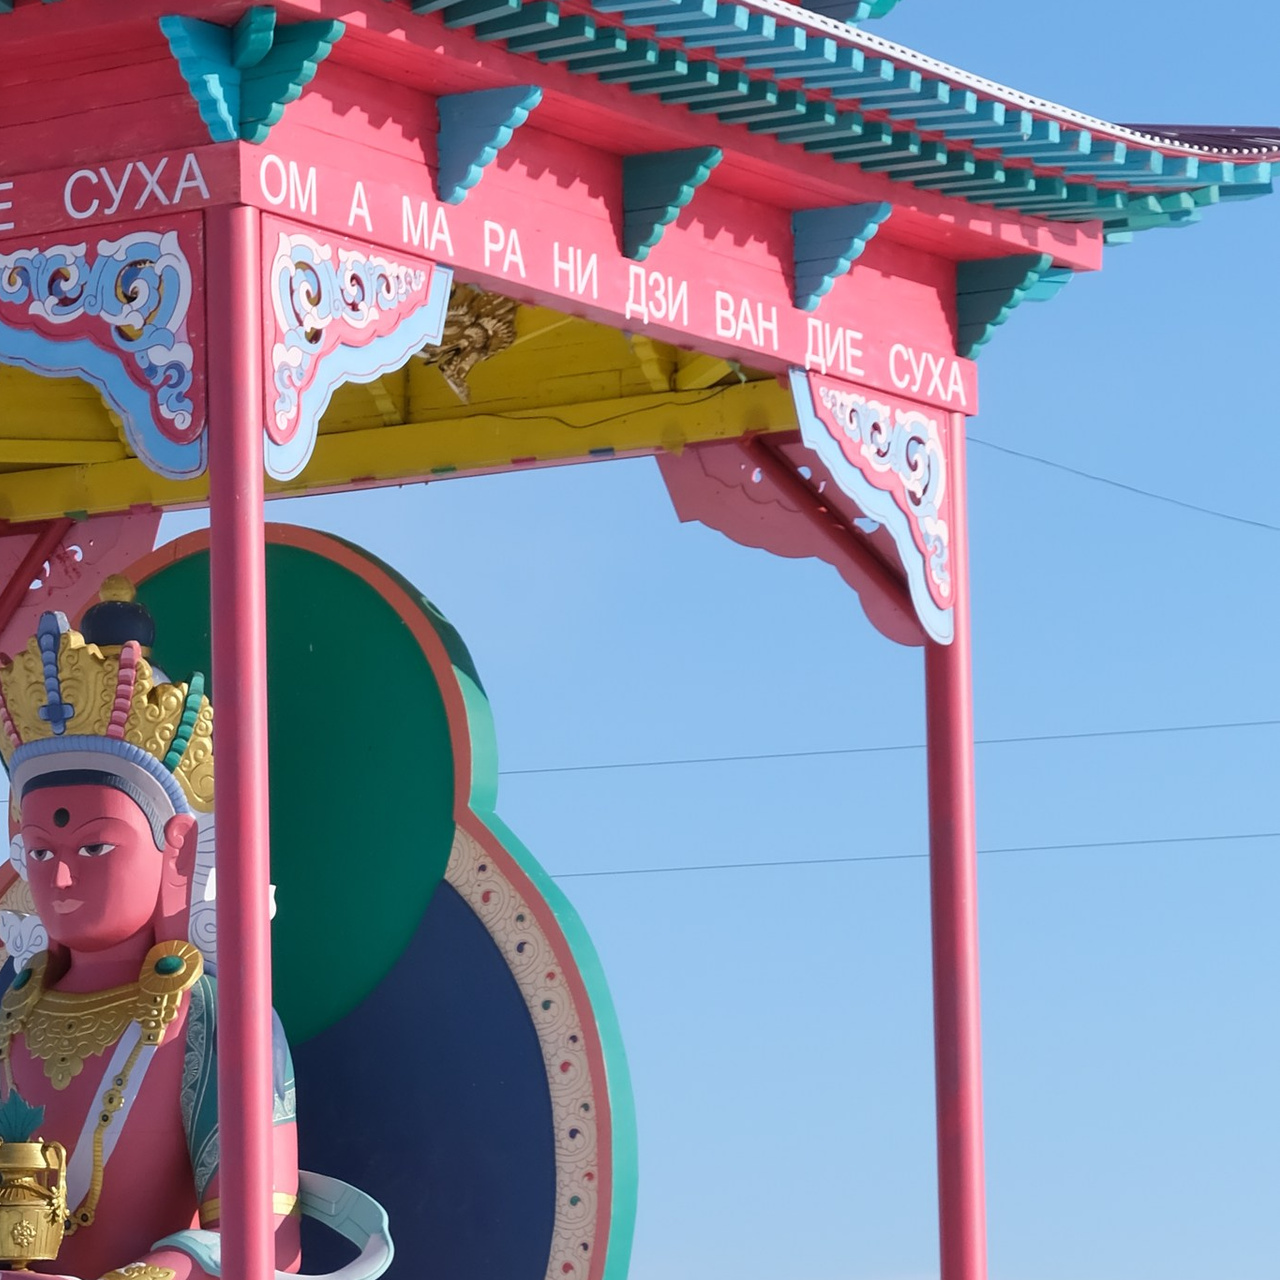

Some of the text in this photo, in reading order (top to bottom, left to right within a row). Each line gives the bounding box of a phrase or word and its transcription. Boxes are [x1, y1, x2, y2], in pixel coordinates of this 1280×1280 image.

[63, 152, 211, 220] СУХА
[259, 153, 967, 407] ОМ А МА РА НИ ДЗИ ВАН ДИЕ СУХА
